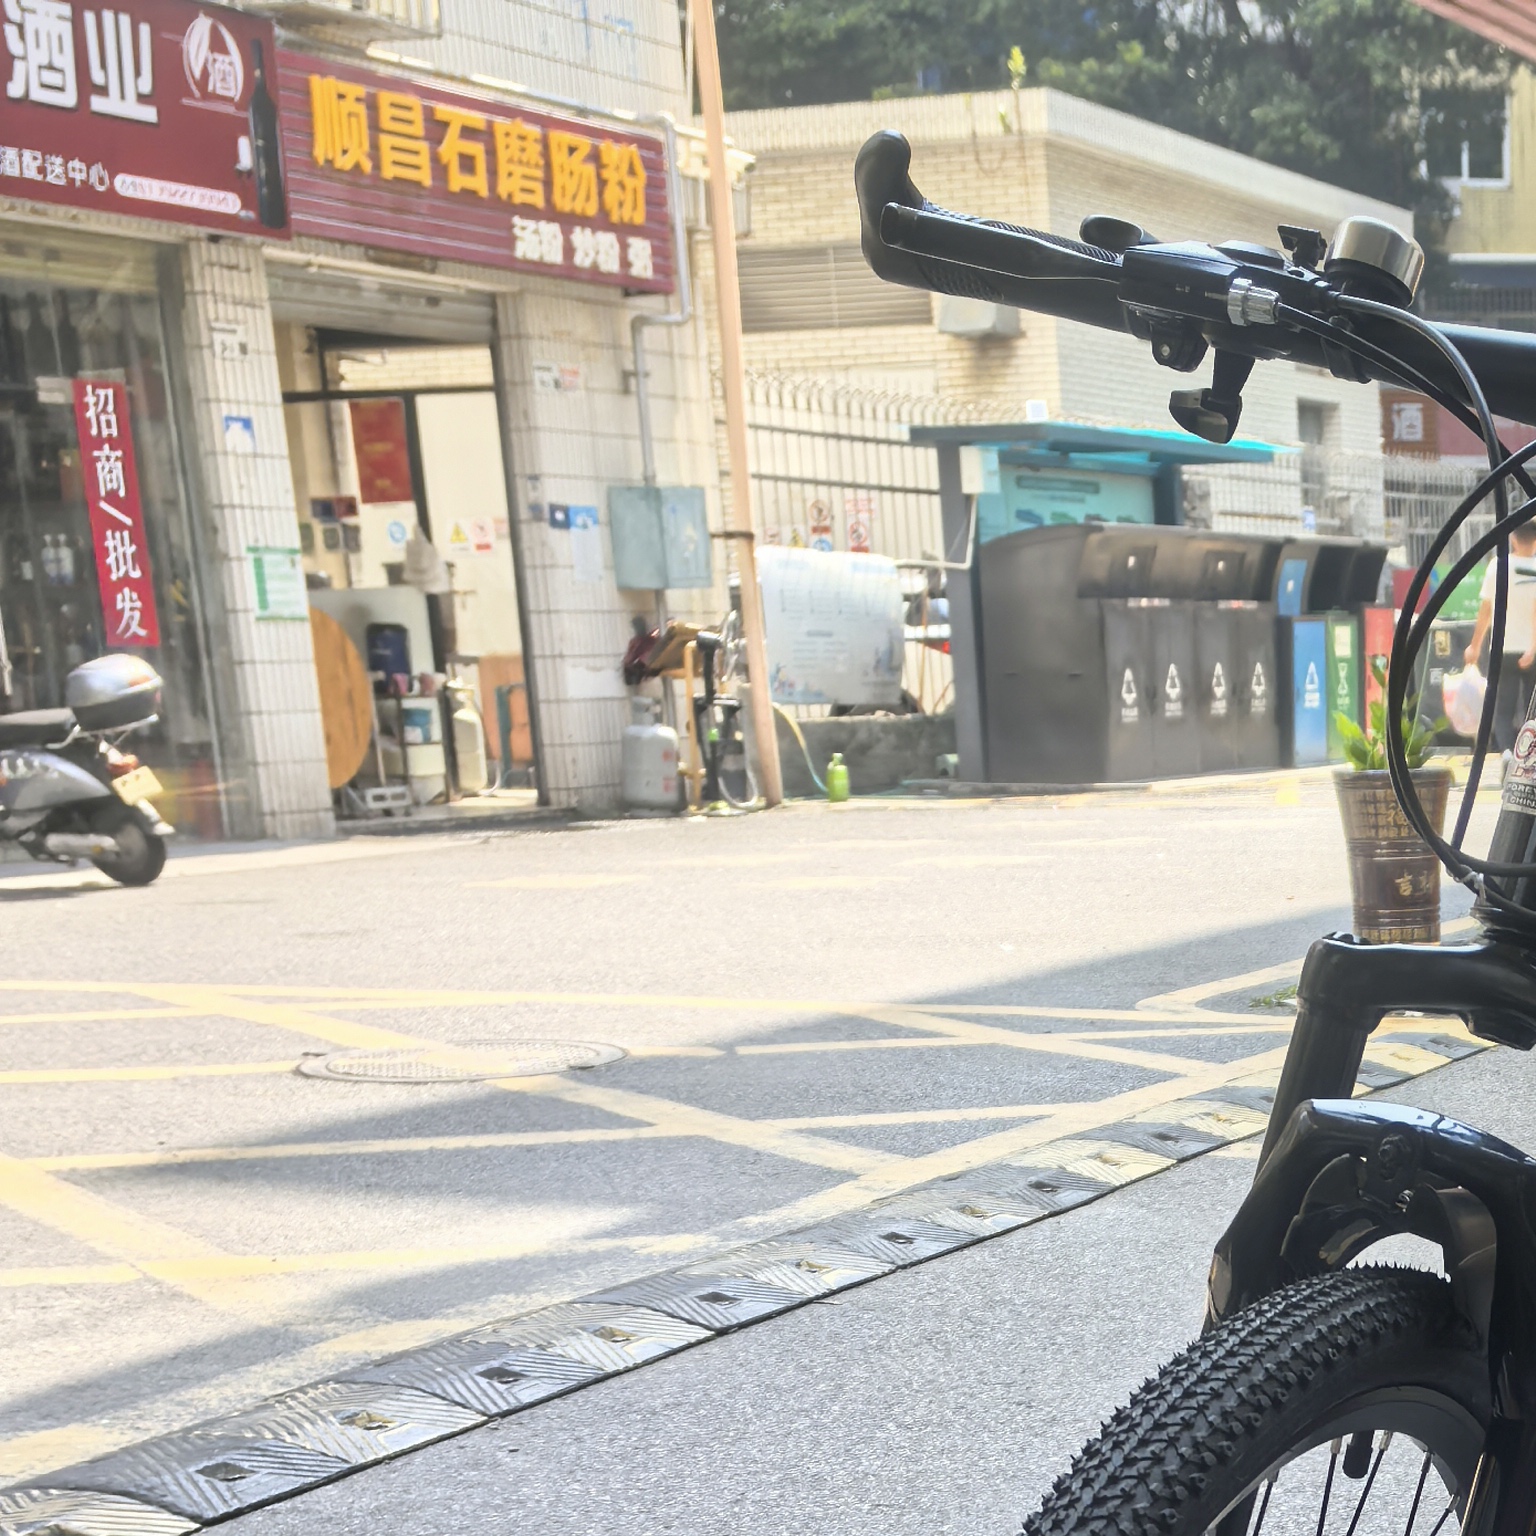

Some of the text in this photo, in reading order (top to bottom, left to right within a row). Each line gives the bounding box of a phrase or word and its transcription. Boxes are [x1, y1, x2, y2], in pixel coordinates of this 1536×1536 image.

[3, 0, 158, 123] 酒业
[309, 73, 647, 225] 顺昌石磨肠粉
